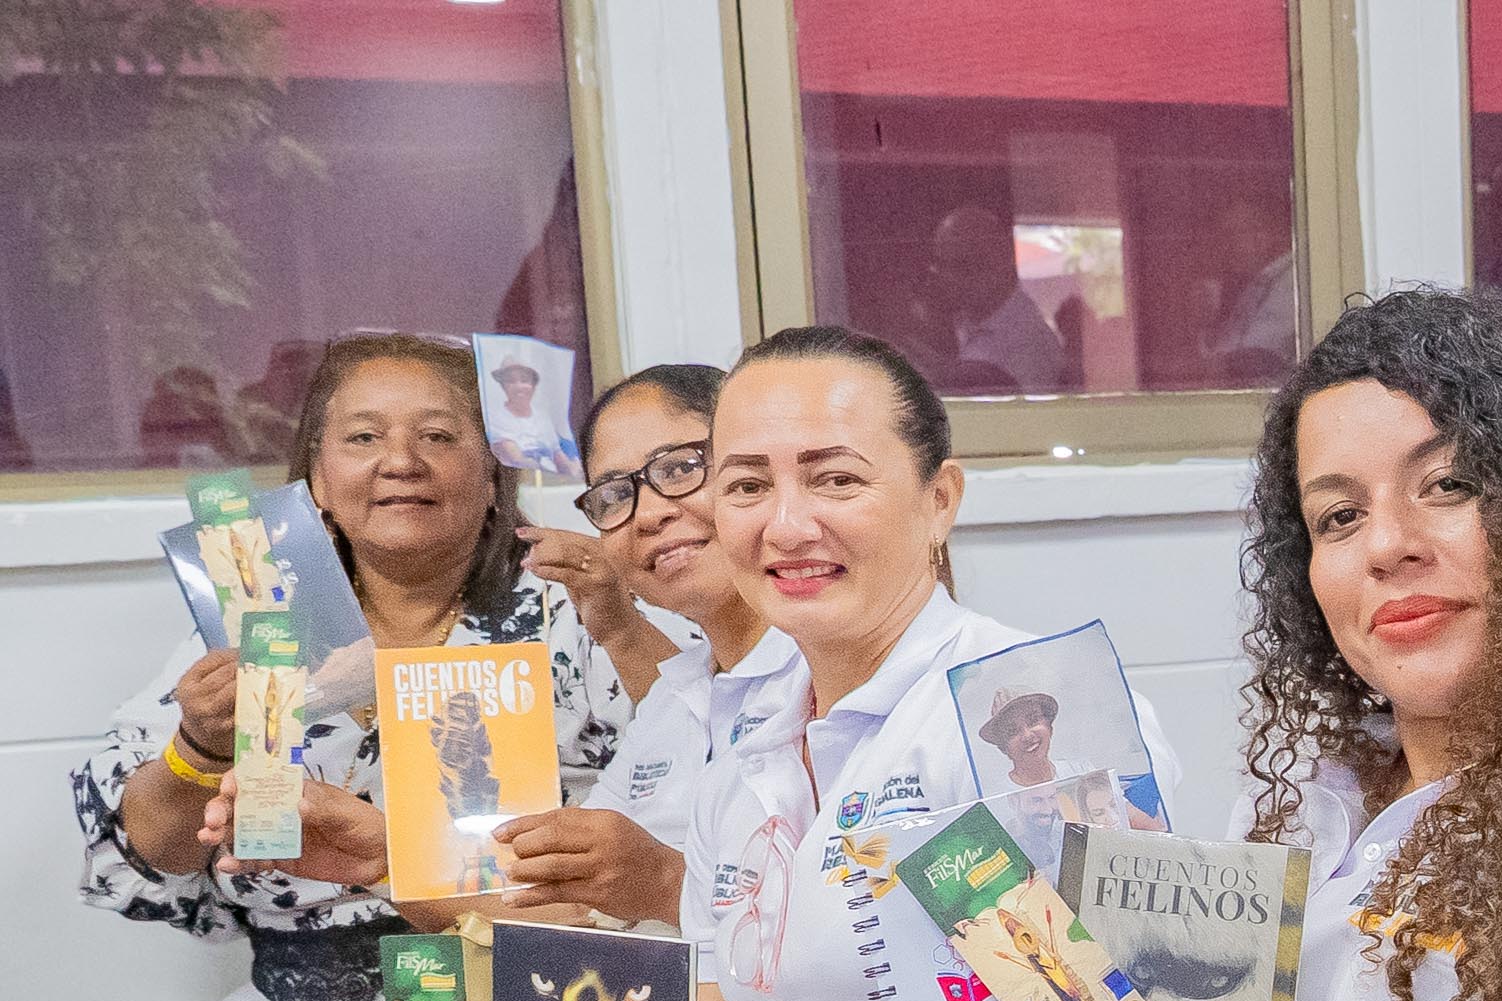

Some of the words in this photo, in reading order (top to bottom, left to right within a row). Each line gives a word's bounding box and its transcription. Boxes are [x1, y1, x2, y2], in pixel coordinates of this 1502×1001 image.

[394, 659, 498, 692] CUENTOS
[499, 659, 536, 716] 6
[1109, 853, 1259, 892] CUENTOS
[1093, 875, 1270, 925] FELINOS
